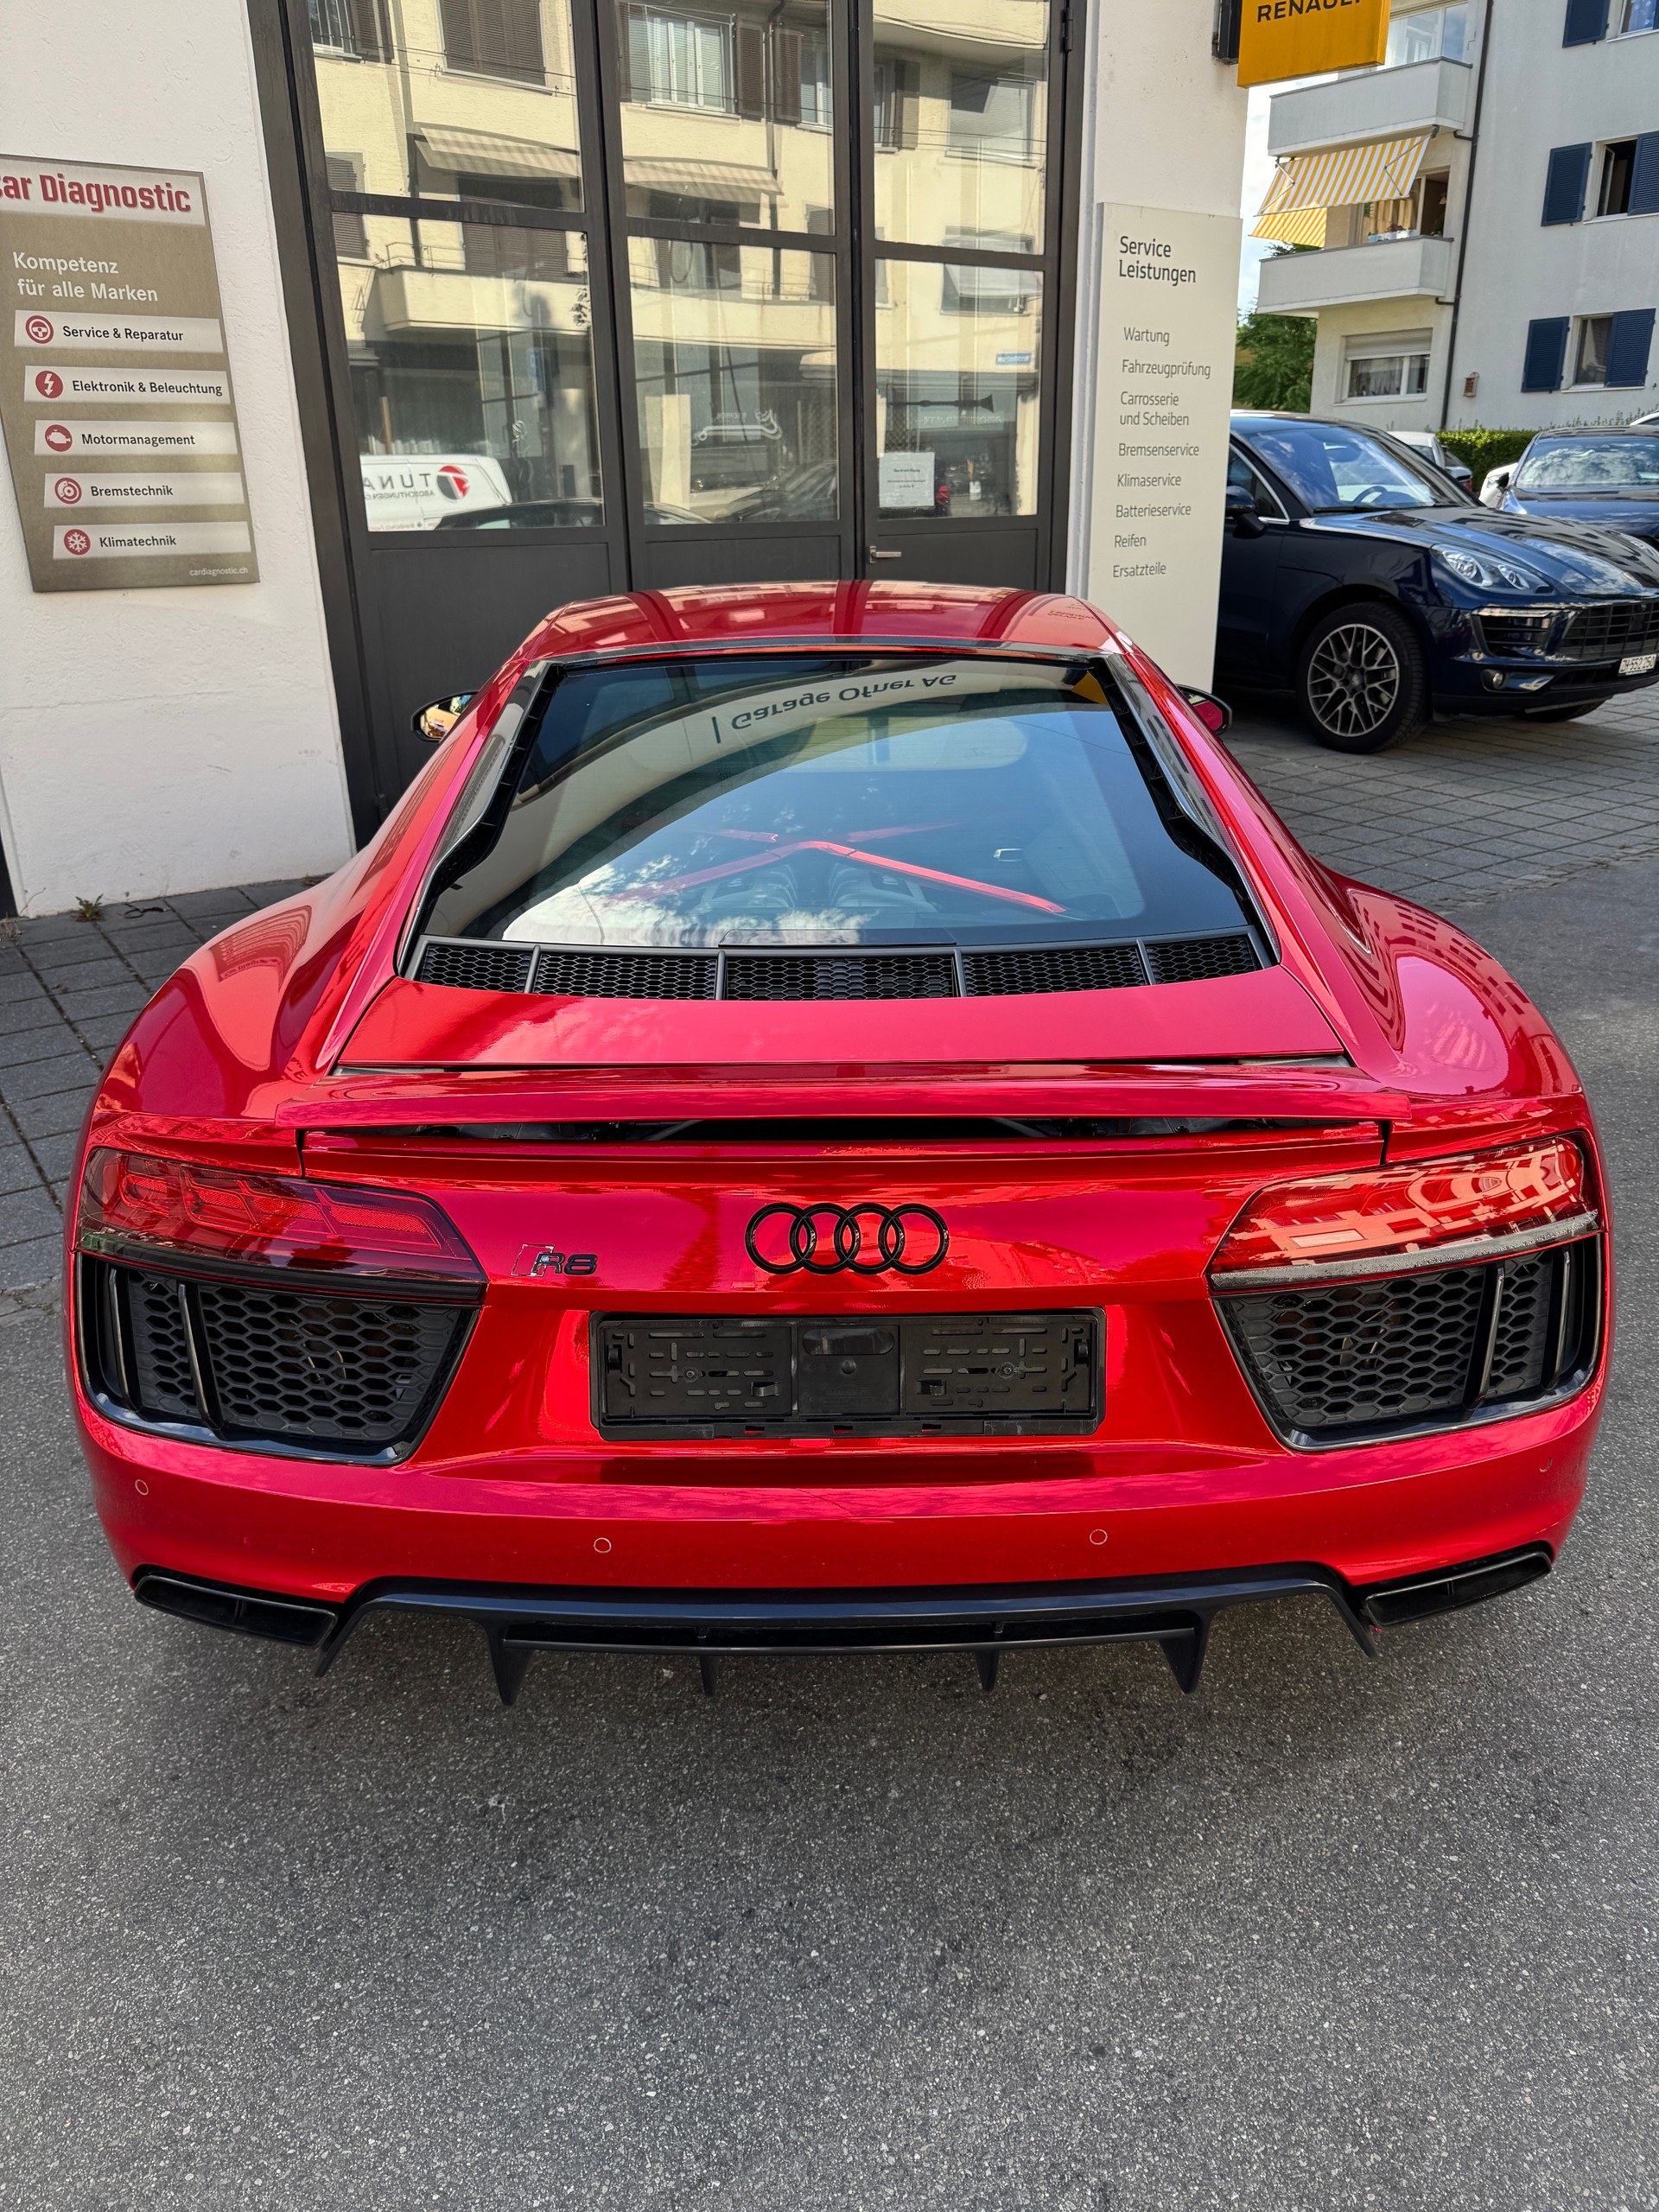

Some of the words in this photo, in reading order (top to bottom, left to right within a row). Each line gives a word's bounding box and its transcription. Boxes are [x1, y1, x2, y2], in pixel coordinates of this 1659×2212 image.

[1256, 0, 1361, 23] RENAU
[0, 175, 32, 200] ar
[39, 173, 192, 213] Diagnostic
[1119, 235, 1173, 257] Service
[12, 251, 119, 276] Kompetenz
[1119, 259, 1197, 287] Leistungen
[17, 277, 46, 296] für
[52, 281, 86, 298] alle
[90, 282, 159, 302] Marken
[62, 325, 110, 339] Service
[112, 327, 122, 339] &
[124, 327, 184, 342] Reparatur
[1123, 326, 1171, 346] Wartung
[1122, 359, 1211, 380] Fahrzeugprüfung
[72, 380, 136, 393] Elektronik
[138, 382, 147, 393] &
[149, 381, 223, 397] Beleuchtung
[1120, 391, 1179, 406] Carrosserie
[1119, 411, 1141, 426] und
[1142, 411, 1190, 426] Scheiben
[81, 433, 196, 448] Motormanagement
[1118, 442, 1199, 457] Bremsenservice
[1116, 473, 1182, 487] Klimaservice
[90, 485, 174, 497] Bremstechnik
[1116, 503, 1192, 518] Batterieservice
[99, 535, 177, 548] Klimatechnik
[1114, 533, 1147, 548] Reifen
[189, 566, 249, 577] cardiagnostic.ch
[1112, 562, 1166, 578] Ersatzteile
[531, 1252, 599, 1276] R8
